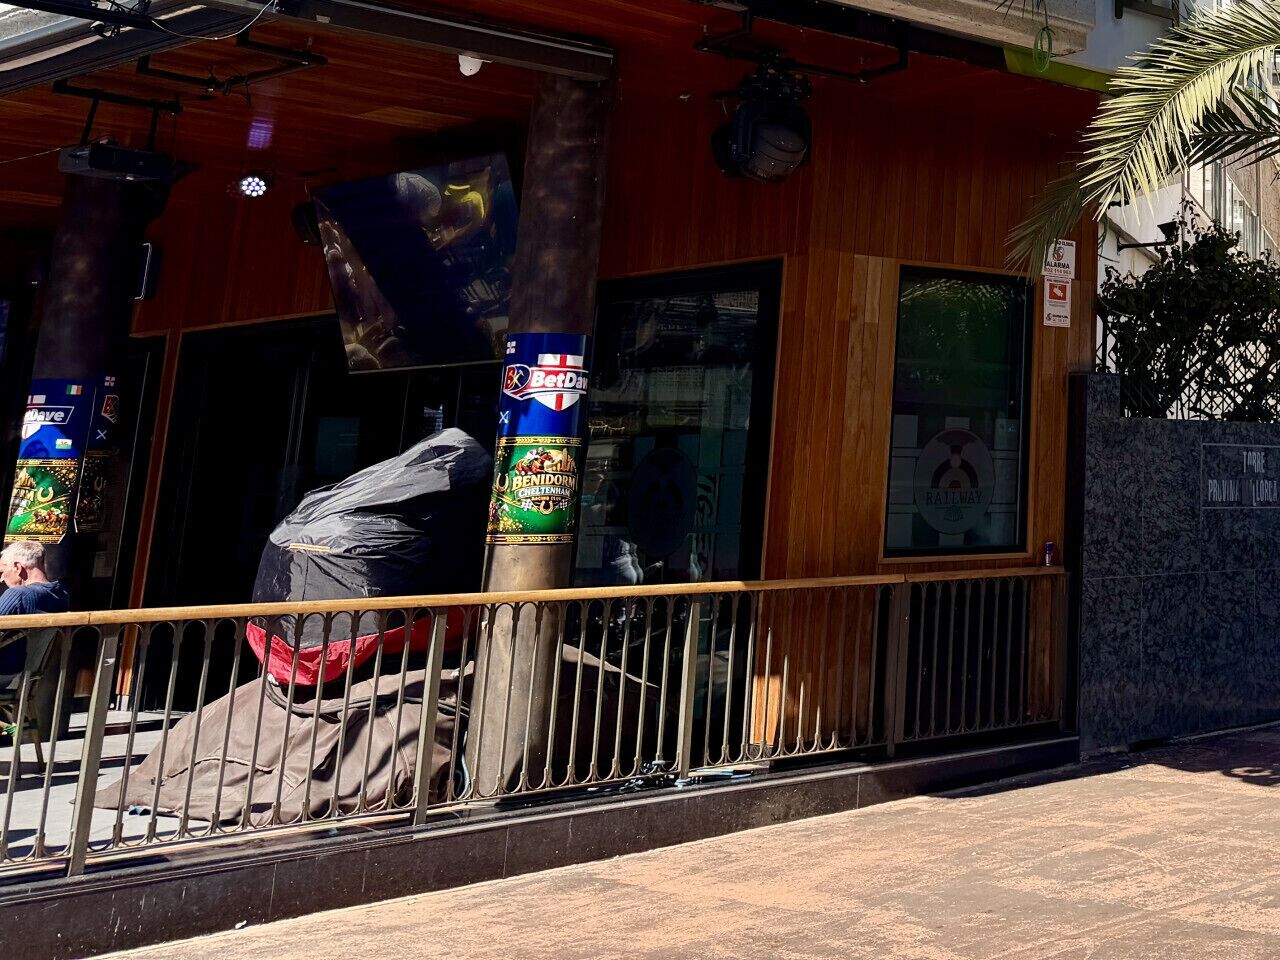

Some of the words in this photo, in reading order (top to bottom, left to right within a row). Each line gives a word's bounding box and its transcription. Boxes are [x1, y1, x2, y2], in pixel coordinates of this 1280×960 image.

[1046, 261, 1070, 270] ALARMA
[511, 474, 577, 491] BENIDORM
[926, 491, 984, 505] RAILWAY
